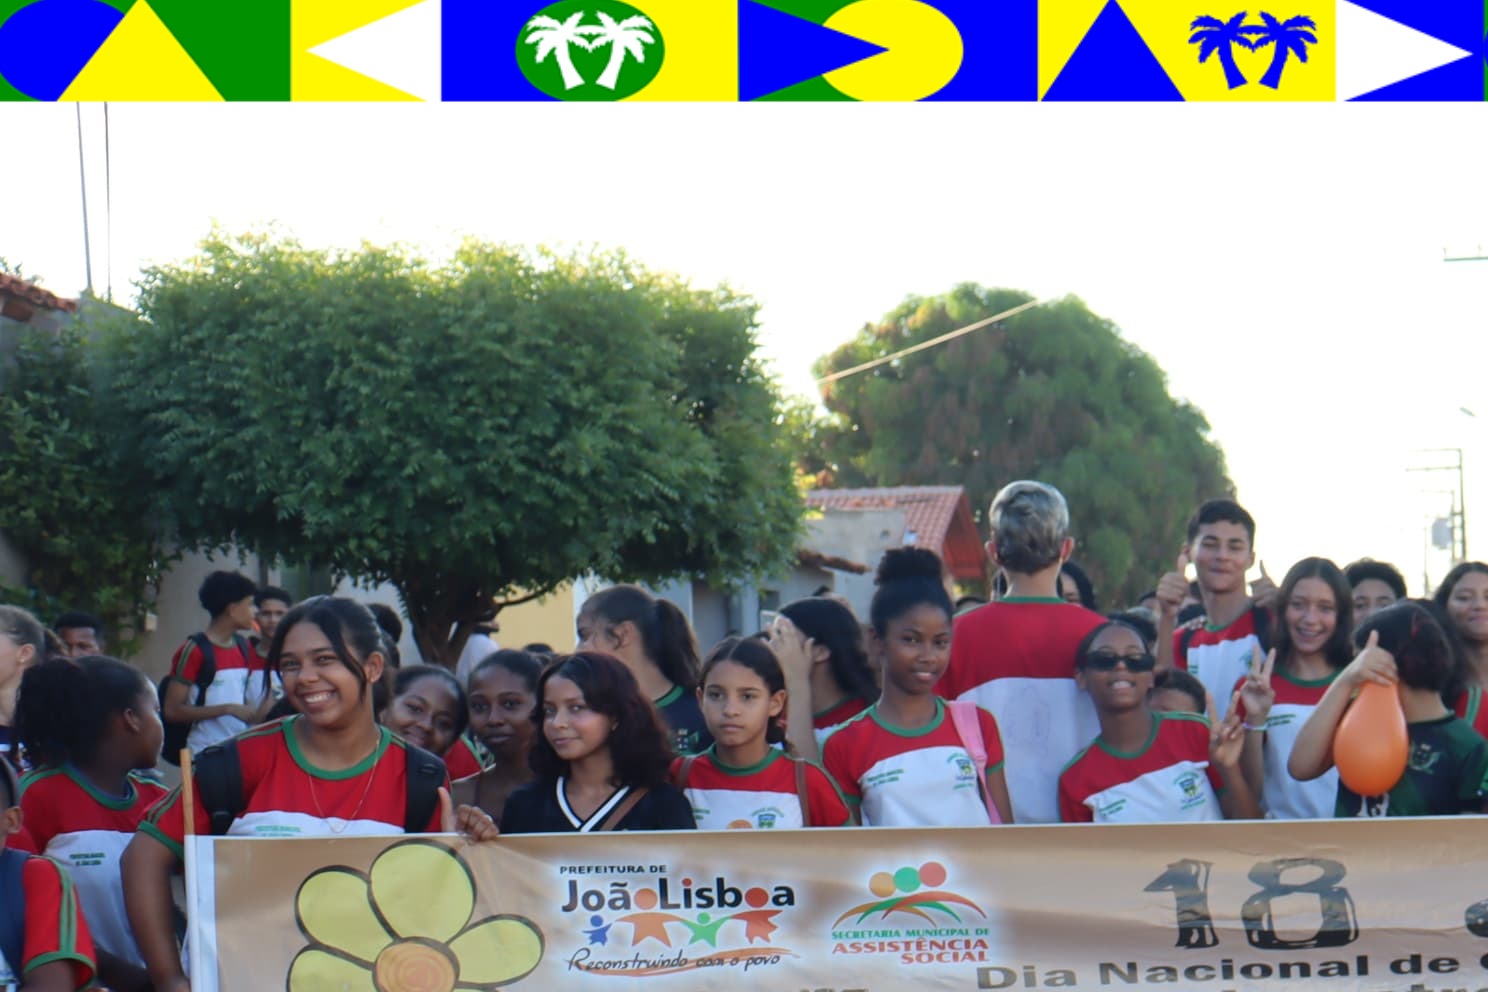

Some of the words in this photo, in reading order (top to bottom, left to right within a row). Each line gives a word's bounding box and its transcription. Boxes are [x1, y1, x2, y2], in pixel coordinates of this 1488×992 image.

[560, 865, 645, 875] PREFEITURA
[650, 864, 667, 874] DE
[1143, 857, 1360, 950] 18
[832, 929, 901, 940] SECRETARIA
[904, 927, 971, 938] MUNICIPAL
[975, 927, 990, 936] DE
[832, 937, 989, 955] ASSISTÊNCIA
[567, 947, 688, 972] Reconstruindo
[695, 956, 726, 968] com
[730, 956, 739, 967] o
[744, 953, 781, 972] povo
[901, 951, 990, 965] SOCIAL
[976, 962, 1078, 990] Dia
[1099, 955, 1369, 986] Nacional
[1389, 954, 1460, 975] de
